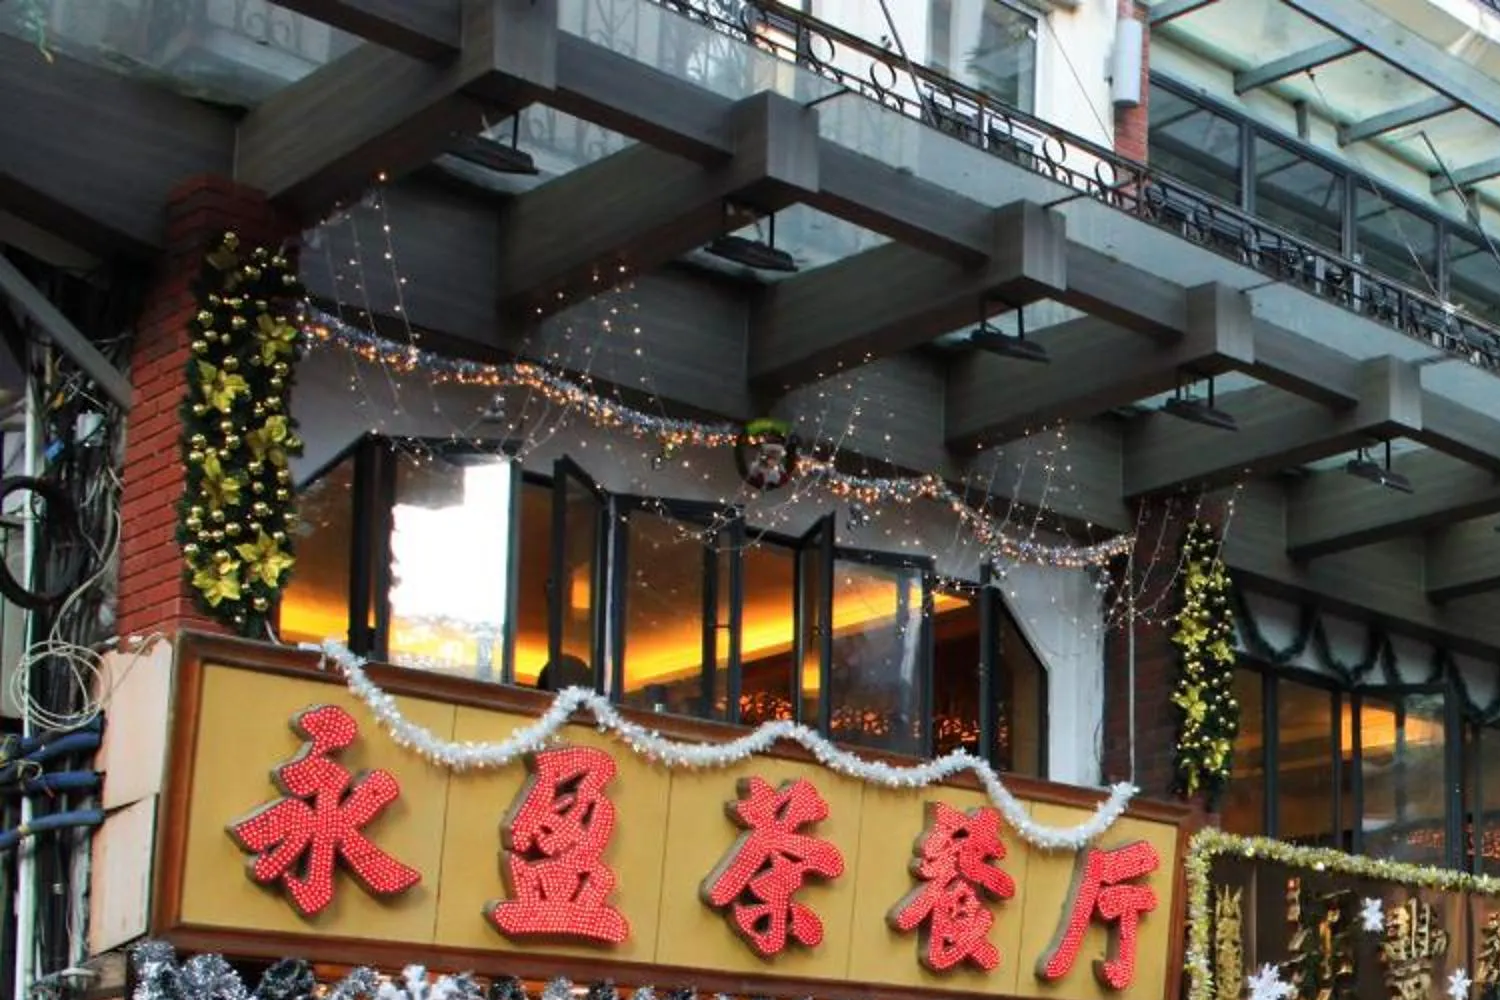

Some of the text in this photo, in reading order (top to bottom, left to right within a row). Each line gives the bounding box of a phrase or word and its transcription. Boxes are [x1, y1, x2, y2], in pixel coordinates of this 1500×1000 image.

[225, 703, 1160, 990] 永盈茶餐厅
